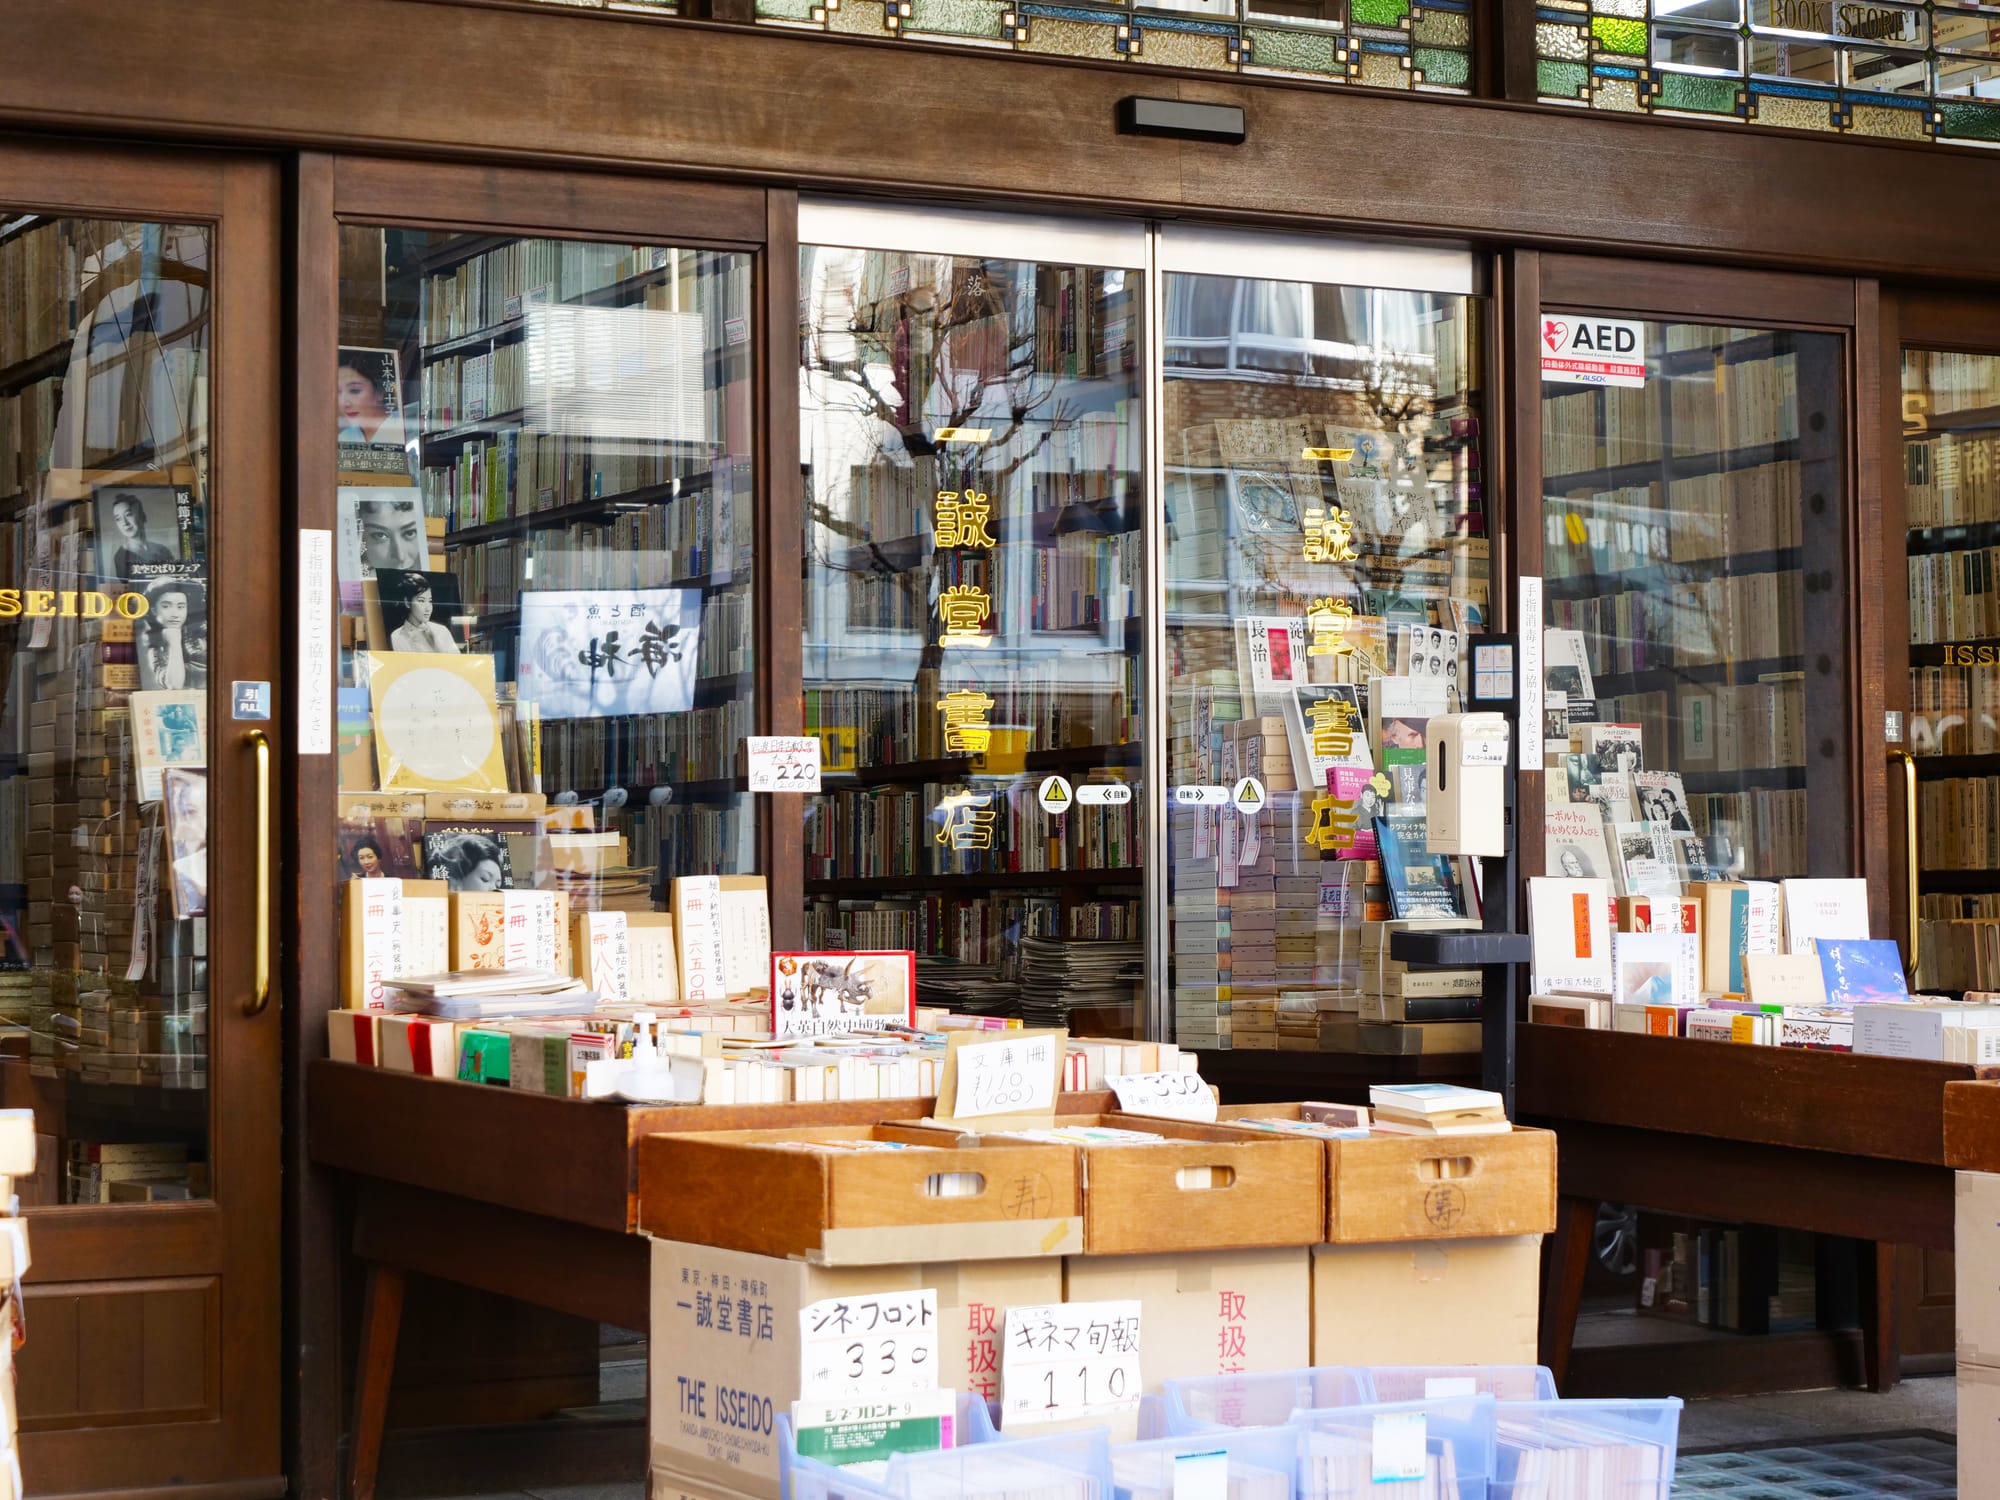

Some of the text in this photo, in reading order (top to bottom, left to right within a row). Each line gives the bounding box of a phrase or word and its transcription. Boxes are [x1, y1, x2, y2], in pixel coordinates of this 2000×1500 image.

[1769, 0, 1910, 42] BOOK STORE
[1571, 323, 1636, 353] AED
[1581, 374, 1607, 383] ALSOK
[176, 491, 193, 531] 原節子
[130, 563, 202, 575] 美空ひばりフェア
[0, 588, 150, 619] SEIDO
[308, 535, 326, 748] 手指消毒にご協力ください
[933, 427, 997, 851] 一誠堂書店
[1251, 620, 1268, 664] 長治
[1289, 620, 1306, 663] 淀川
[1300, 446, 1360, 852] 一誠堂書店
[1942, 644, 2000, 667] ISS
[1524, 581, 1539, 765] 手指消毒にご協力ください
[239, 702, 264, 713] PULL
[244, 687, 259, 700] 引
[776, 763, 817, 781] 220
[1113, 790, 1128, 799] 自動
[1178, 790, 1193, 800] 自動
[427, 833, 451, 880] 高峰
[1652, 823, 1666, 865] 西洋音楽
[367, 892, 385, 918] 一冊
[686, 886, 705, 911] 一冊
[1751, 897, 1765, 918] 一冊
[508, 904, 528, 929] 一冊
[1671, 903, 1680, 934] 早春
[592, 923, 609, 946] 一冊
[974, 1047, 1015, 1069] 文庫
[974, 1072, 1024, 1097] ¥110
[974, 1084, 1034, 1111] (100)
[1143, 1074, 1200, 1097] 330
[681, 1267, 769, 1299] 東京・神田・神保町
[676, 1290, 774, 1342] 一誠堂書店
[810, 1298, 933, 1335] シネ・フロント
[1014, 1316, 1140, 1355] キネマ旬報
[845, 1339, 929, 1380] 330
[1043, 1365, 1126, 1409] 110
[677, 1376, 707, 1419] THE
[716, 1385, 774, 1437] ISSEIDO
[824, 1402, 898, 1423] シネ・フロント
